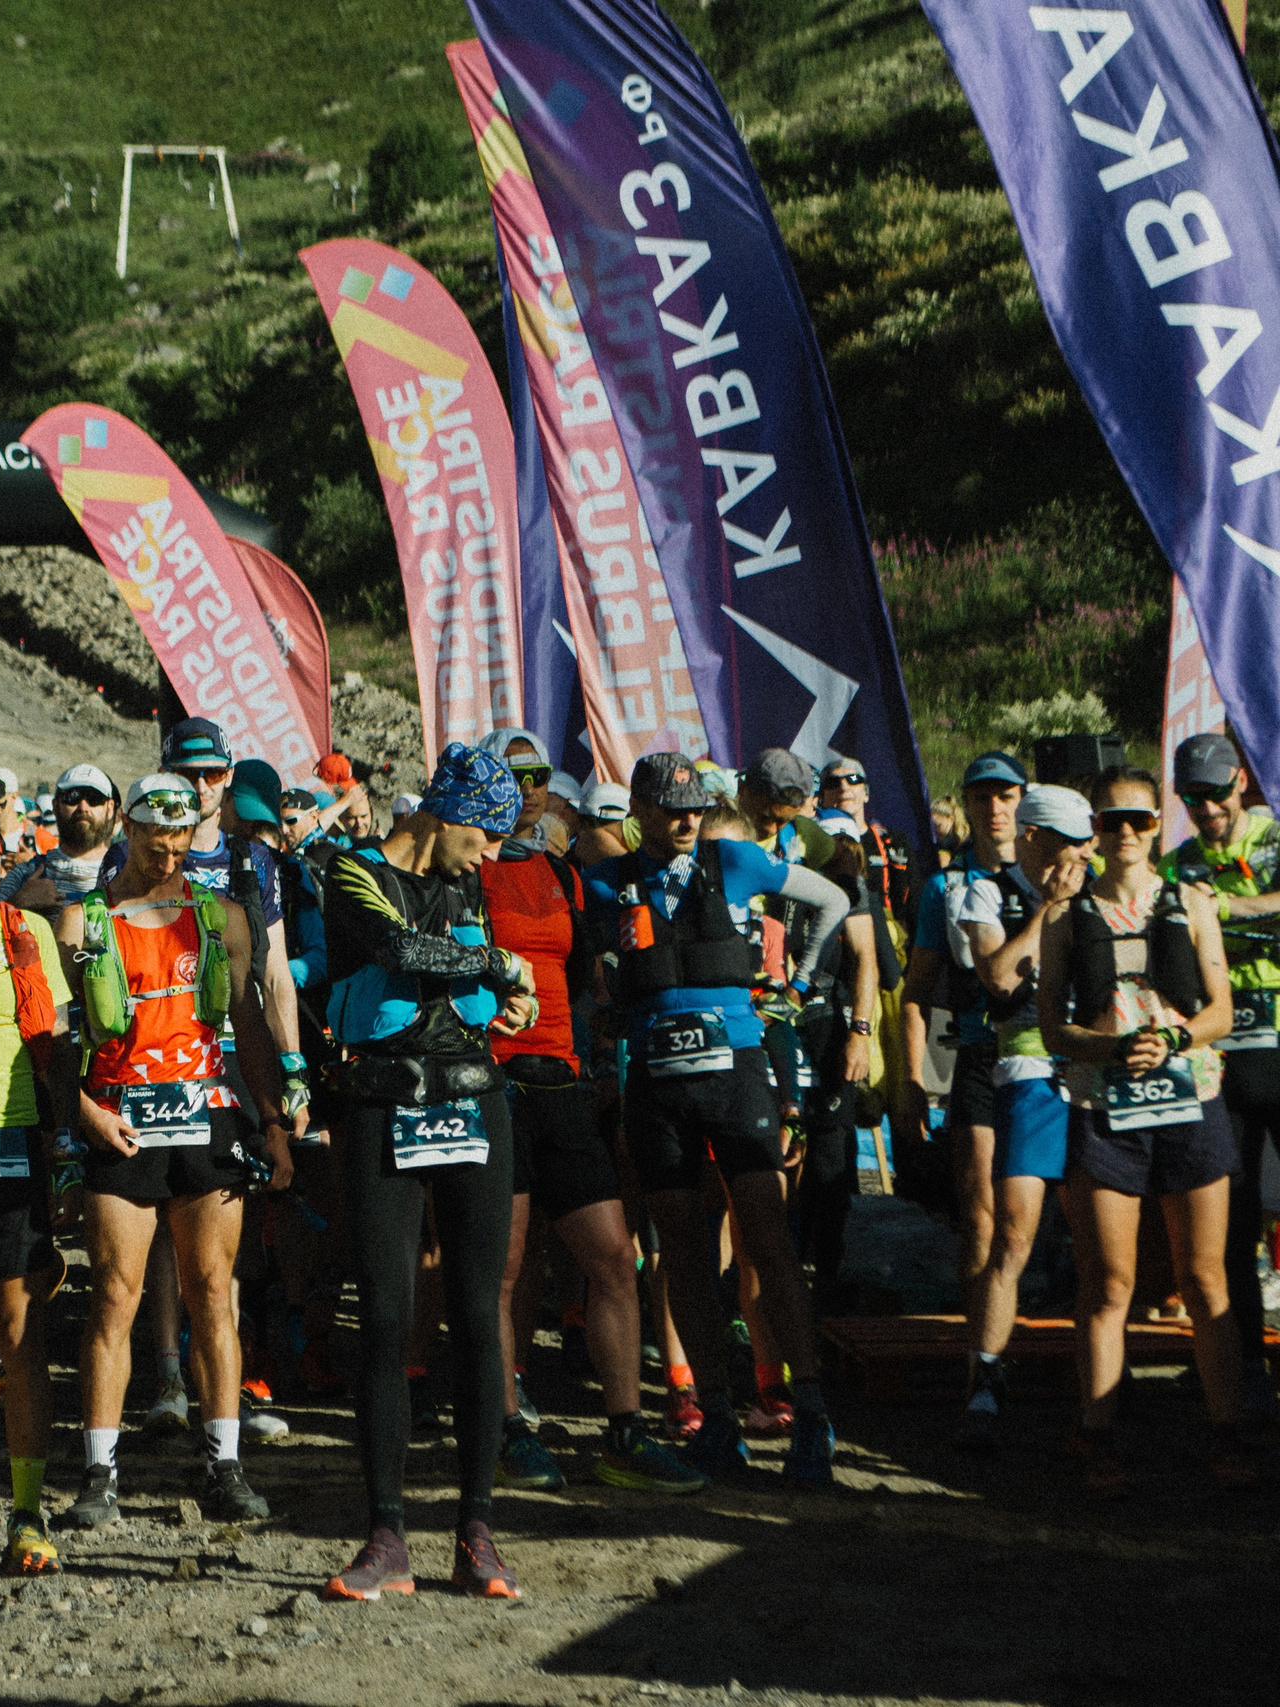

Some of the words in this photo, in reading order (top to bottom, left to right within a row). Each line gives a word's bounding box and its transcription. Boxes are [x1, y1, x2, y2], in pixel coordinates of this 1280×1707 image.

[669, 1028, 705, 1052] 321
[1127, 1079, 1176, 1103] 362
[142, 1102, 190, 1123] 344
[415, 1118, 468, 1140] 442
